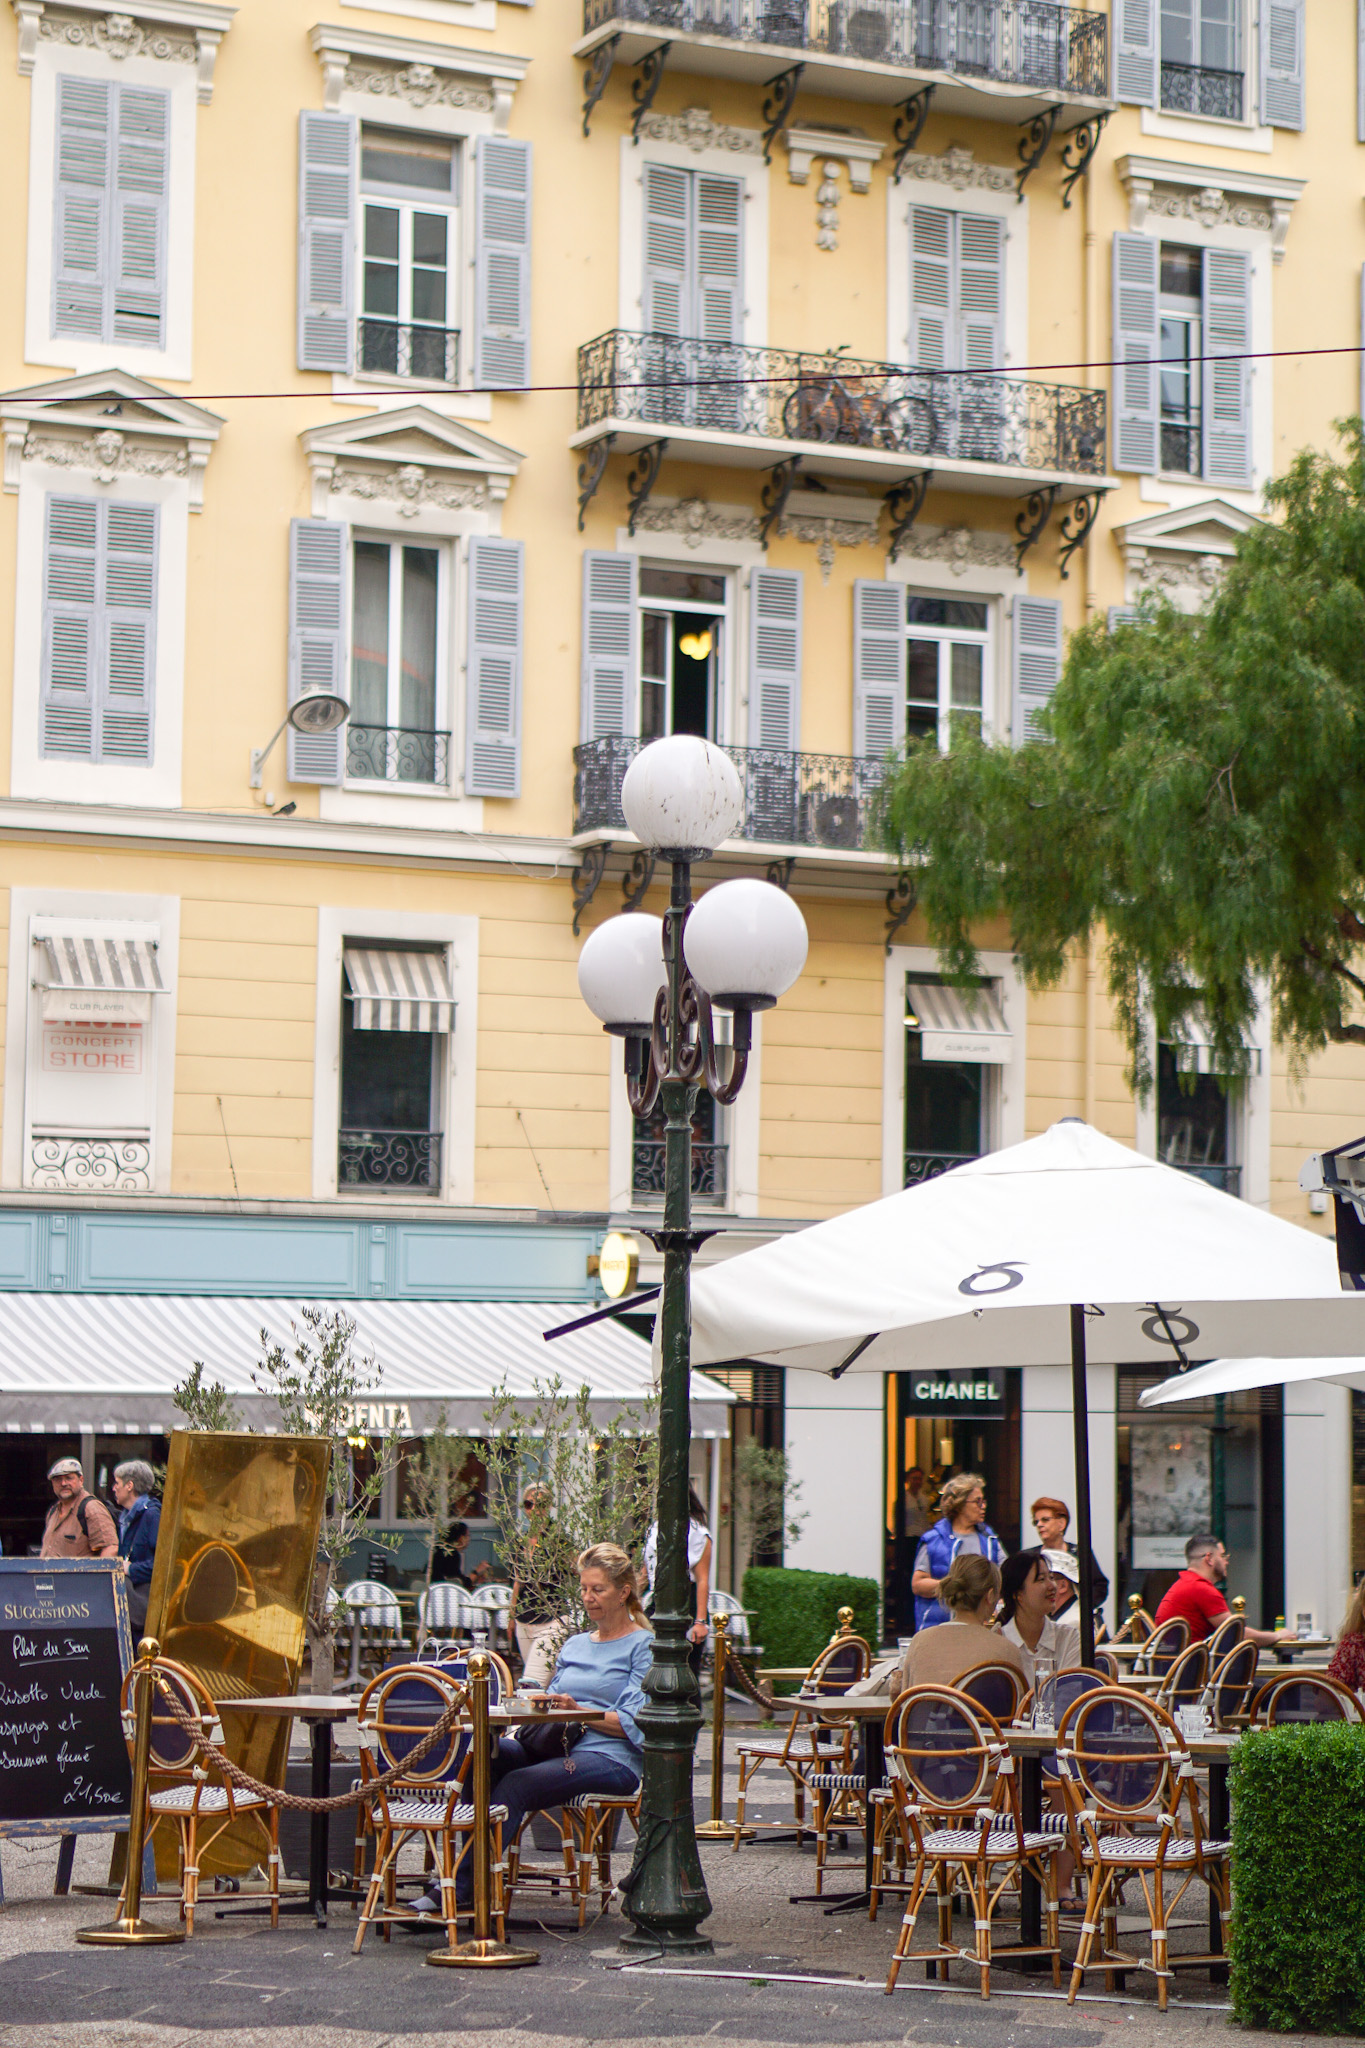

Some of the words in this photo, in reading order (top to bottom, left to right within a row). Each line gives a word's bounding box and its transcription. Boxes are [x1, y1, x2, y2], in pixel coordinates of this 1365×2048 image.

[50, 1036, 135, 1048] CONCEPT
[50, 1051, 135, 1069] STORE
[915, 1382, 1000, 1400] CHANEL
[4, 1603, 90, 1619] SUGGESTIONS
[13, 1634, 38, 1659] Plat
[43, 1640, 60, 1657] du
[58, 1712, 82, 1732] et
